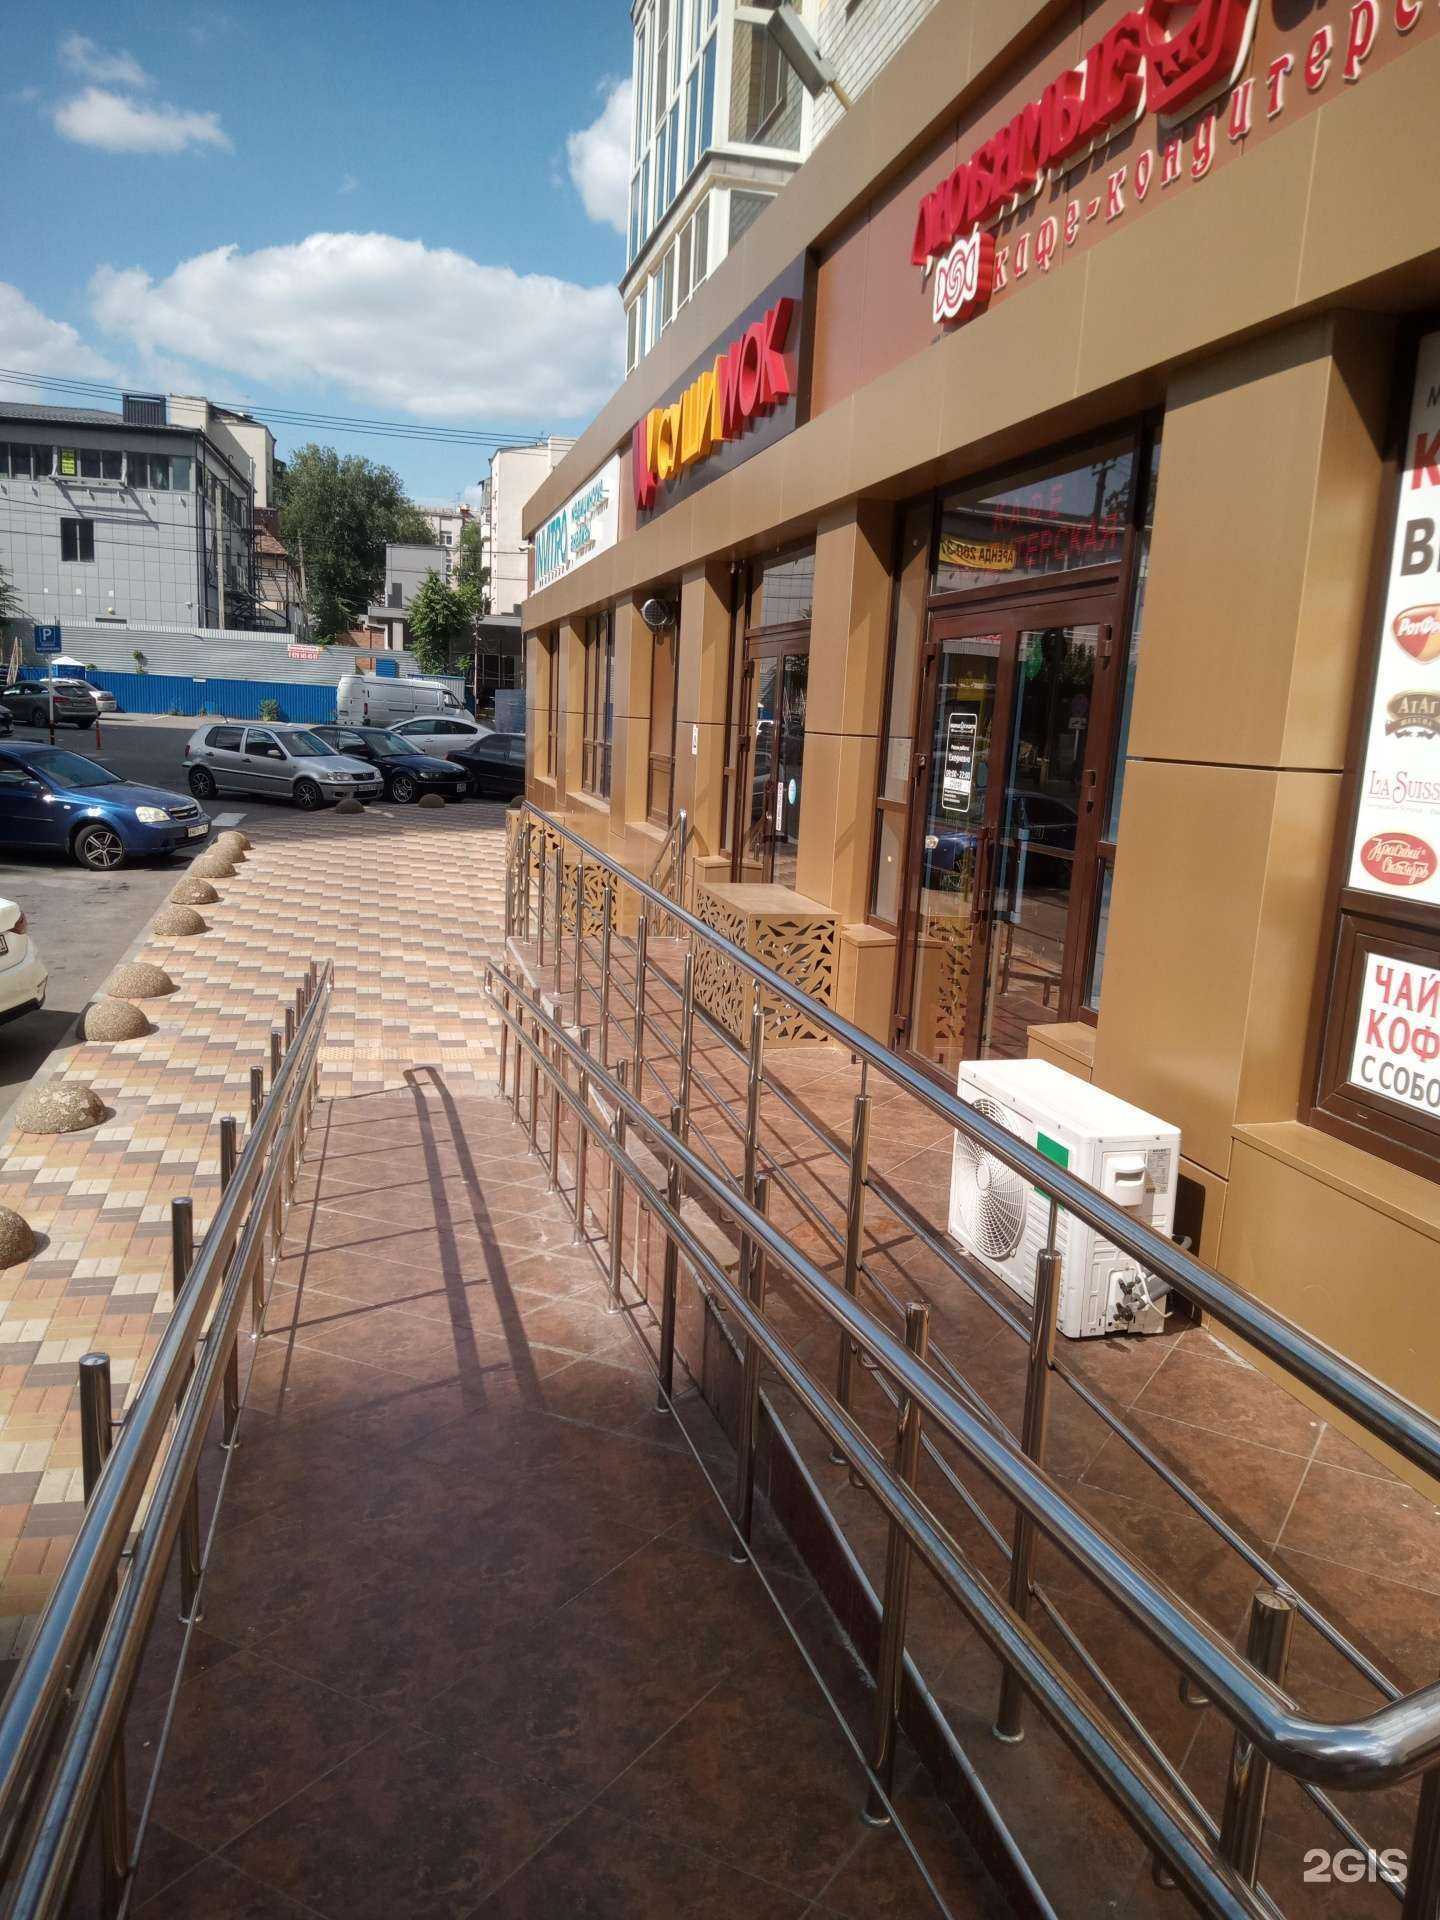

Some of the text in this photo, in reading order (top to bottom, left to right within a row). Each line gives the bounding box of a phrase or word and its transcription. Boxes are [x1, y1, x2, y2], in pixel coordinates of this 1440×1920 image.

[1392, 771, 1440, 803] SUISS
[1375, 965, 1440, 1018] ЧАЙ
[1365, 1009, 1440, 1062] КОФ
[1379, 1061, 1440, 1108] СОБО
